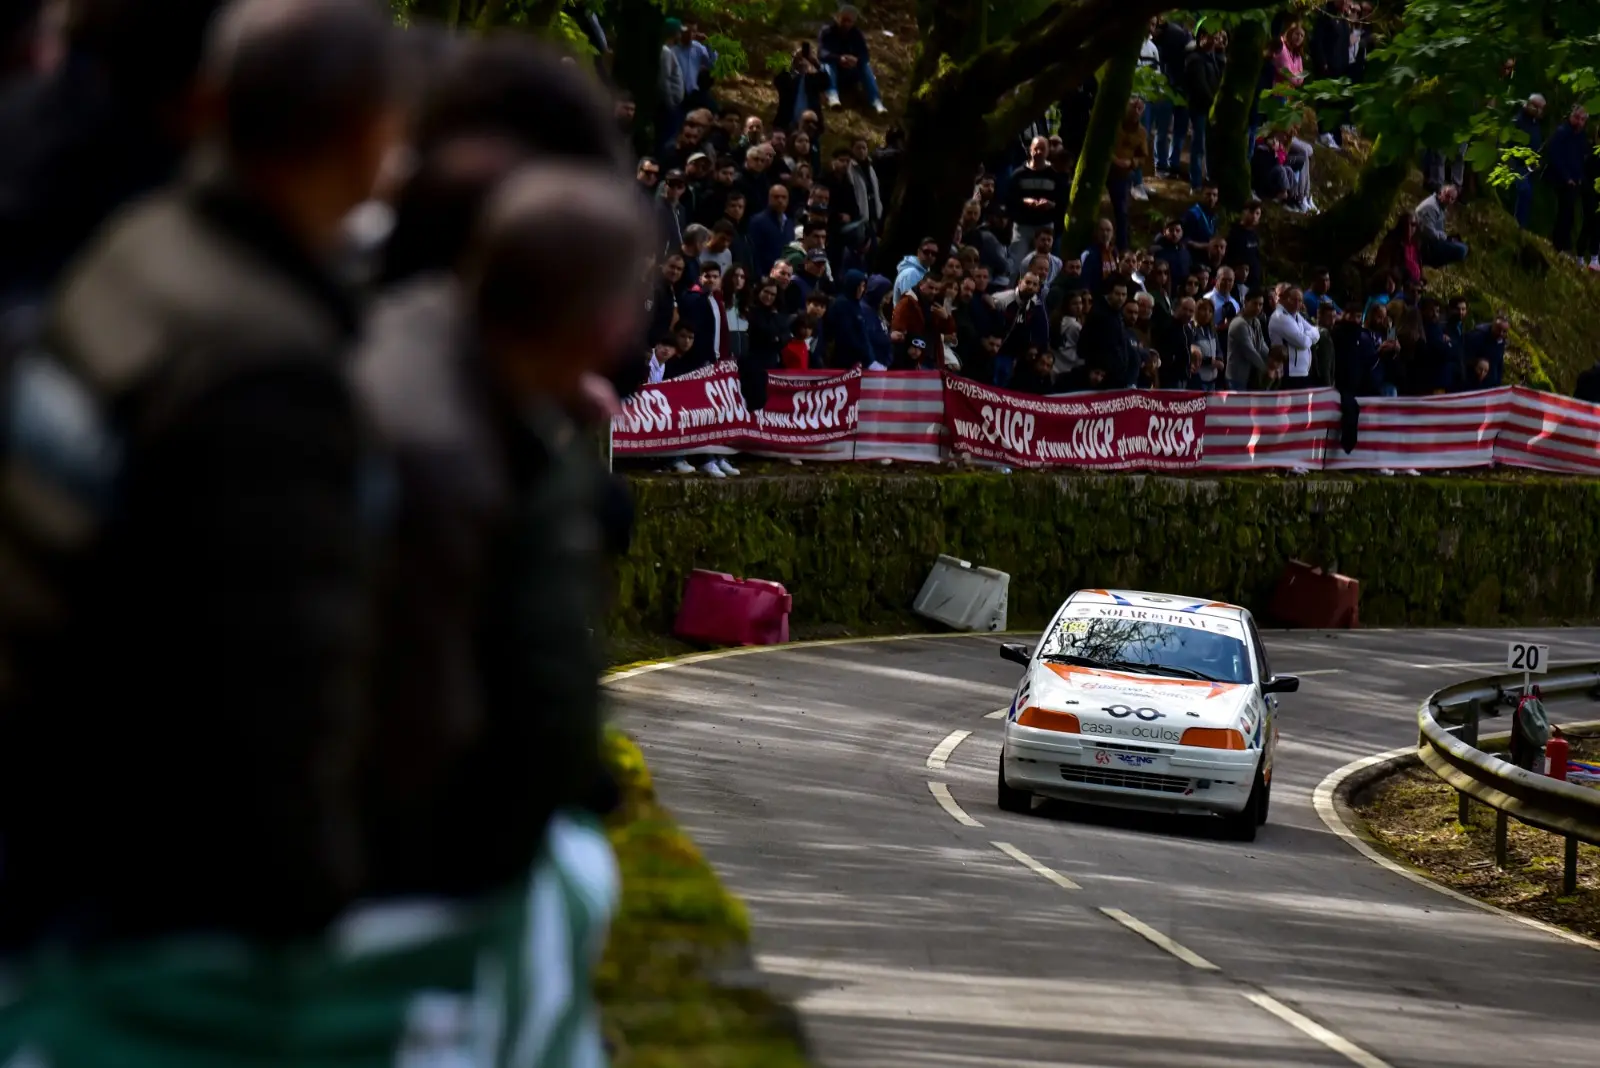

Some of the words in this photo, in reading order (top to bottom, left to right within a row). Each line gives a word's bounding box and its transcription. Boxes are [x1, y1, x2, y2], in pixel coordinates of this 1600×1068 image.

[1092, 397, 1126, 414] PENHORES
[1169, 397, 1207, 414] PENHORES
[1098, 608, 1148, 619] SOLAR
[1512, 644, 1539, 670] 20
[1081, 722, 1113, 734] casa
[1131, 724, 1180, 741] óculos
[1114, 753, 1158, 765] RACING
